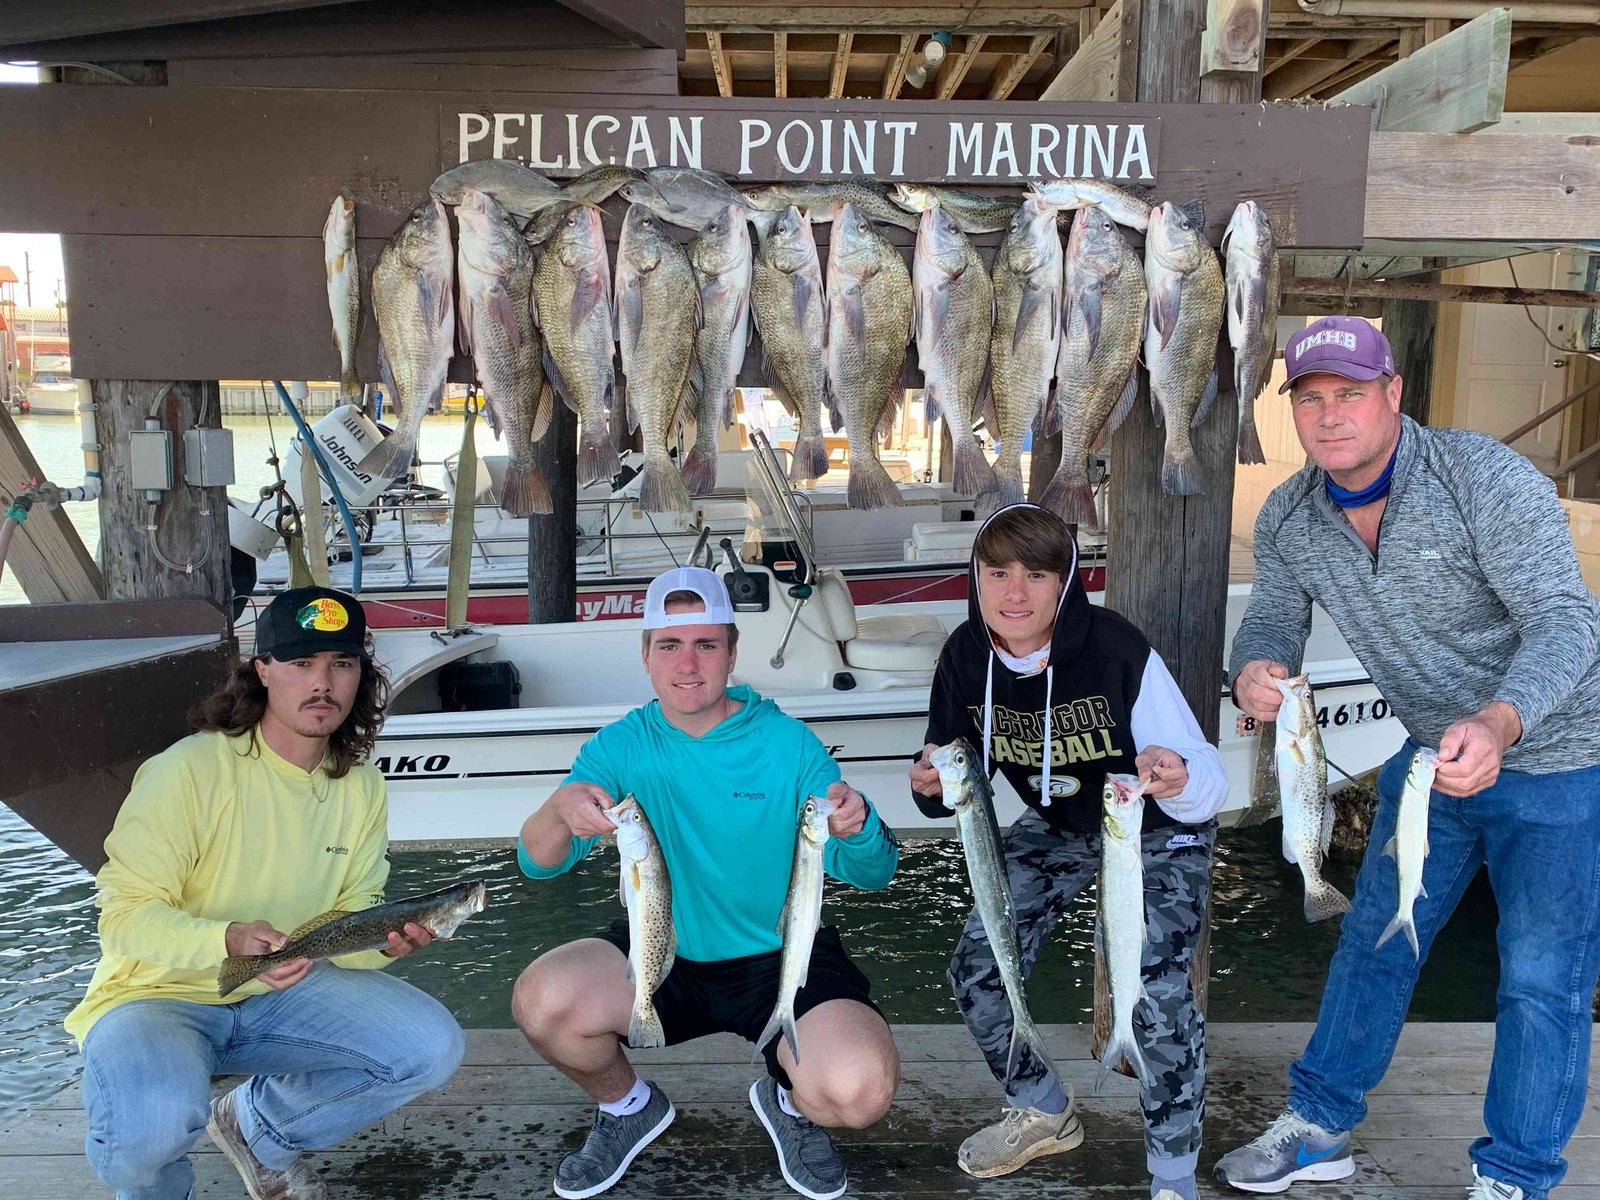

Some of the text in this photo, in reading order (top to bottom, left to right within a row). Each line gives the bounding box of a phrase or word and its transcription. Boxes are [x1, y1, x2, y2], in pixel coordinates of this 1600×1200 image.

[457, 112, 1155, 179] PELICAN POINT MARINA
[1295, 329, 1357, 361] UMHB
[321, 599, 341, 609] Bass
[322, 608, 337, 617] Pro
[576, 594, 647, 621] yMa
[322, 616, 346, 627] Shops
[966, 695, 1117, 741] MCGREGOR
[1243, 716, 1256, 732] 8
[981, 728, 1123, 768] ASEBALL
[1171, 834, 1197, 844] NIKE
